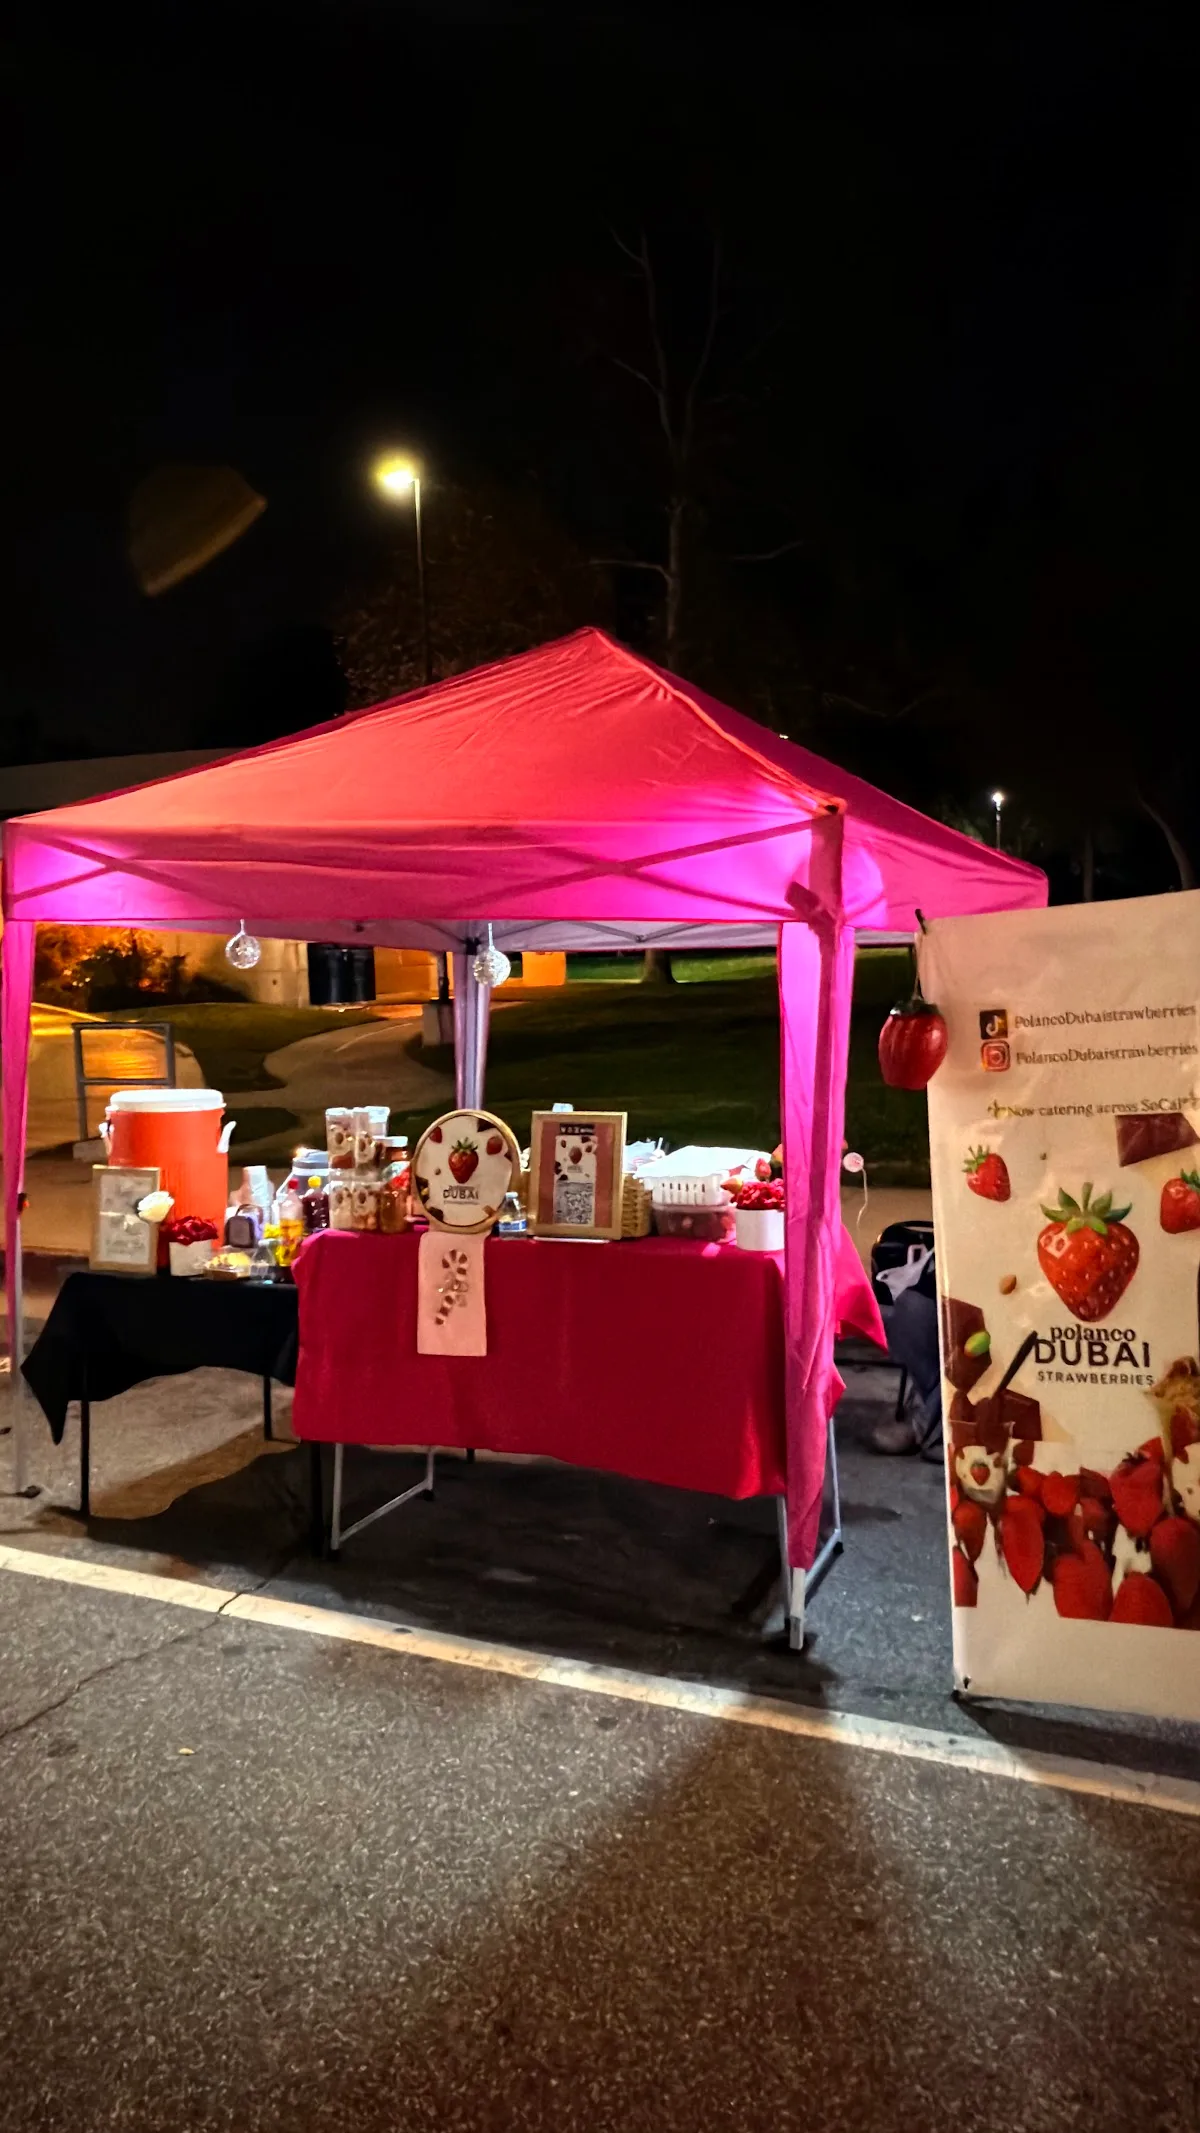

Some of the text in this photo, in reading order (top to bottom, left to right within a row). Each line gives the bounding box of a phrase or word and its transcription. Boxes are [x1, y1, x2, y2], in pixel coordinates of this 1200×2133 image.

[1008, 1098, 1182, 1117] Now catering across SoCal
[443, 1188, 479, 1200] DUBAI
[1050, 1323, 1136, 1343] polanco
[1034, 1338, 1150, 1368] DUBAI
[1038, 1370, 1154, 1386] STRAWBERRIES
